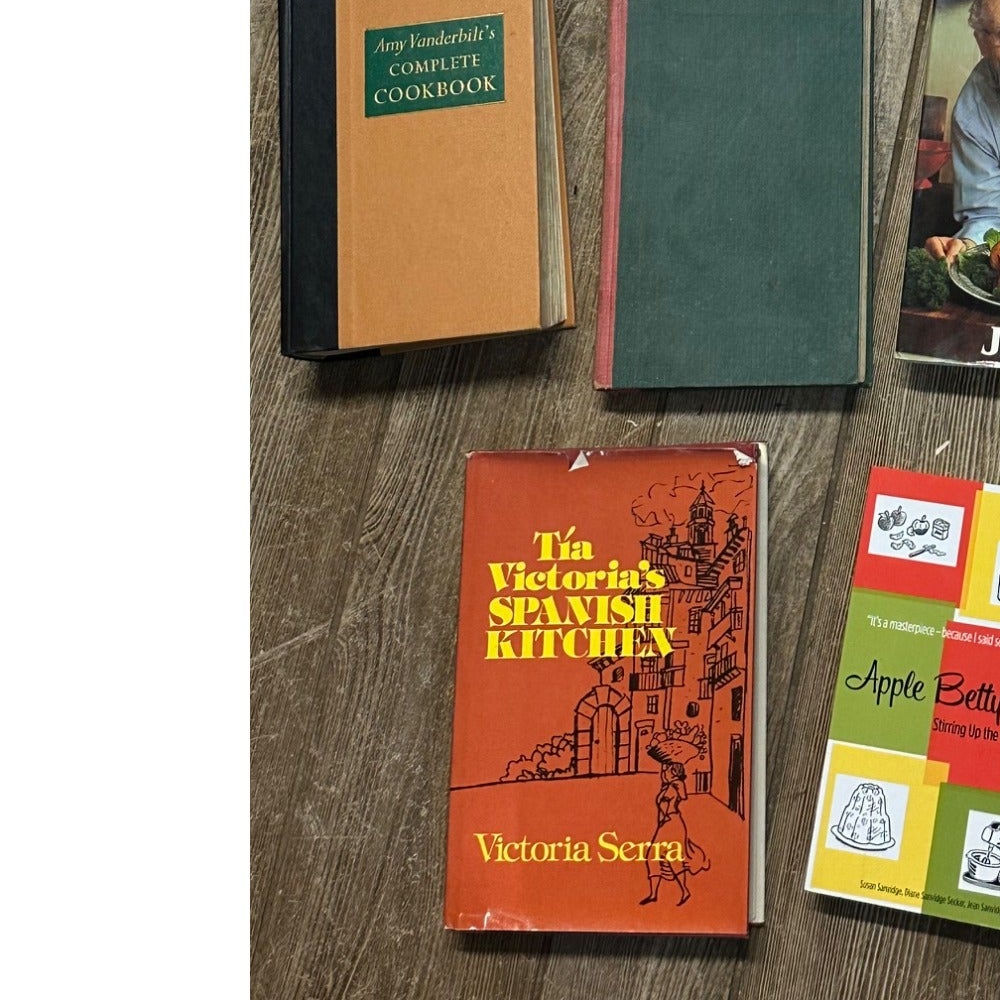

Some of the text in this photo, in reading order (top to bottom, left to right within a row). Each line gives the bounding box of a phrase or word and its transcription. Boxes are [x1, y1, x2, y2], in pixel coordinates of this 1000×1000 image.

[374, 25, 495, 56] Amy Vanderbilt's
[389, 54, 481, 77] COMPLETE
[374, 75, 497, 104] COOKBOOK
[532, 525, 596, 561] Tía
[488, 559, 666, 592] Victoria's
[488, 593, 665, 627] SPANISH
[484, 626, 677, 660] KITCHEN
[977, 632, 994, 646] said
[845, 659, 926, 708] Apple
[932, 718, 966, 738] Stirring
[968, 723, 982, 739] Up
[983, 726, 999, 742] the
[473, 831, 685, 863] Victoria Serra
[860, 880, 877, 890] Susan
